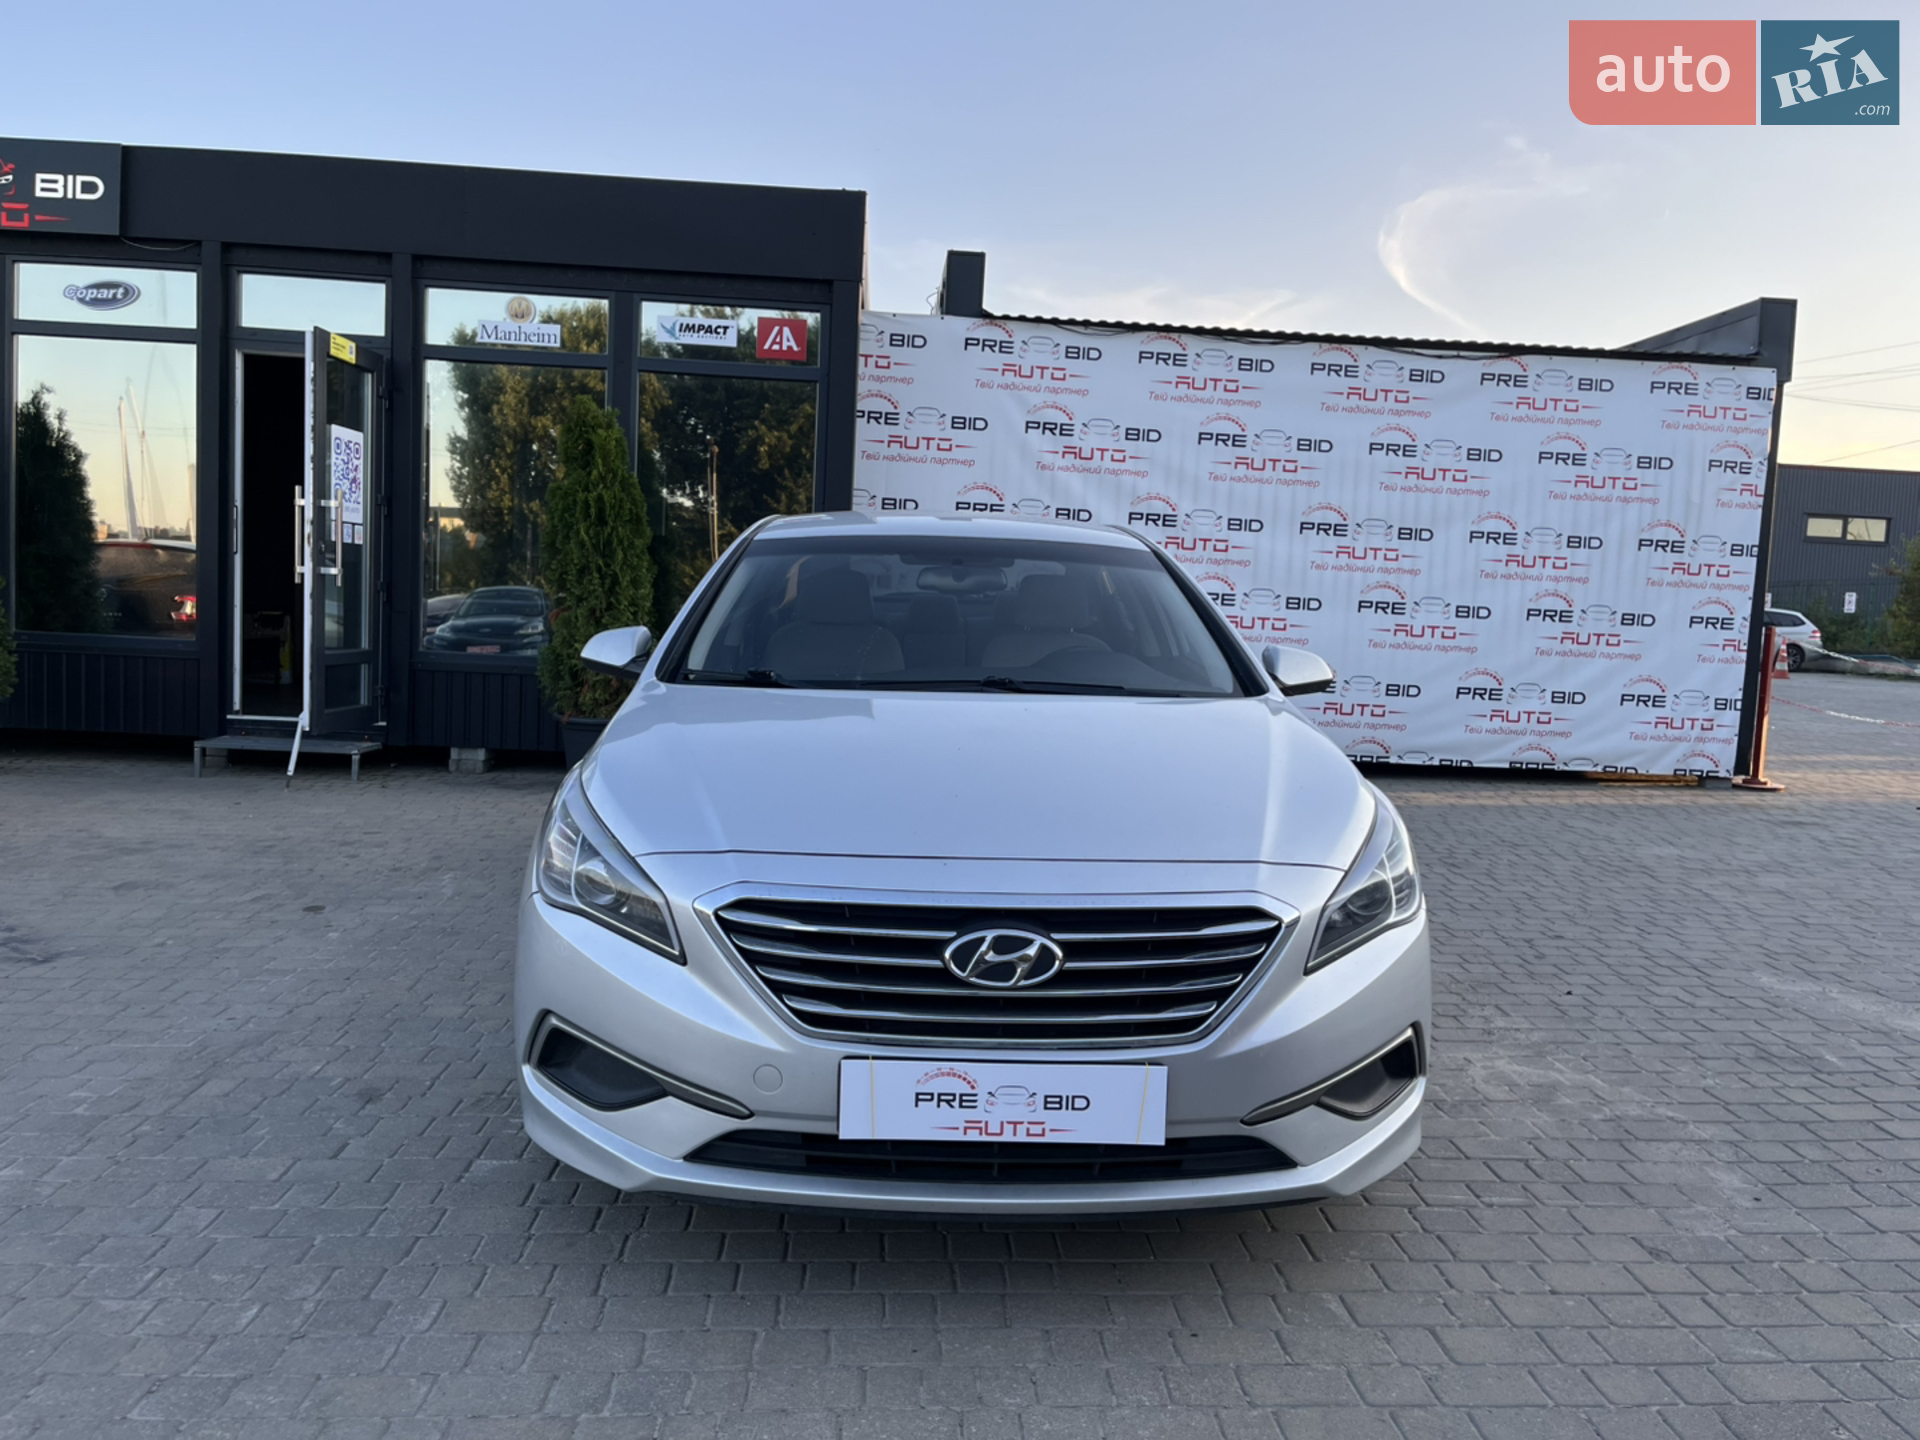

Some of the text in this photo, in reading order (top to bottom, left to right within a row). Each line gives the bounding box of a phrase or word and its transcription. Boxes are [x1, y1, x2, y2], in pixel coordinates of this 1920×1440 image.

[35, 172, 105, 201] BID
[63, 284, 126, 302] Copart
[480, 323, 558, 345] Manheim
[678, 322, 730, 336] IMPACT
[889, 333, 927, 349] BID
[964, 337, 1102, 361] PRE BID
[859, 353, 891, 369] TO
[1138, 351, 1275, 373] PRE BID
[1001, 363, 1066, 381] AUTO
[1311, 362, 1445, 383] PRE BID
[975, 378, 1089, 398] Твій надійний партнер
[1175, 376, 1239, 393] AUTO
[1480, 373, 1614, 392] PRE BID
[1650, 381, 1699, 396] PRE
[1149, 391, 1261, 409] Твій надійний партнер
[1347, 387, 1410, 403] AUTO
[1320, 402, 1431, 419] Твій надійний партнер
[1516, 397, 1579, 413] AUTO
[1687, 404, 1747, 421] AUTO
[951, 416, 988, 431] BID
[1490, 412, 1602, 428] Твій надійний партнер
[1660, 420, 1680, 430] Твій
[1682, 421, 1724, 433] надійний
[1025, 420, 1162, 442] PRE BID
[887, 435, 952, 452] AUTO
[1198, 432, 1333, 453] PRE BID
[861, 450, 975, 468] Твій надійний партнер
[1062, 445, 1126, 463] AUTO
[1369, 442, 1503, 462] PRE BID
[1234, 456, 1298, 473] AUTO
[1538, 451, 1673, 470] PRE BID
[1708, 459, 1753, 475] PRE
[1035, 461, 1149, 479] Твій надійний партнер
[1405, 466, 1468, 483] AUTO
[1208, 472, 1320, 489] Твій надійний партнер
[1574, 475, 1638, 491] AUTO
[1379, 482, 1490, 499] Твій надійний партнер
[1548, 490, 1660, 506] Твій надійний партнер
[881, 497, 919, 510] BID
[1715, 498, 1733, 509] Твій
[1055, 508, 1092, 523] BID
[1128, 512, 1264, 532] PRE BID
[1300, 522, 1434, 541] PRE BID
[1165, 536, 1229, 552] AUTO
[1469, 531, 1603, 549] PRE BID
[1638, 539, 1685, 553] PRE
[1336, 546, 1399, 562] AUTO
[1505, 554, 1568, 570] AUTO
[1205, 557, 1251, 568] партнер
[1310, 561, 1421, 577] Твій надійний партнер
[1671, 562, 1731, 578] AUTO
[1480, 569, 1590, 585] Твій надійний партнер
[1645, 577, 1750, 593] Твій надійний партнер
[1206, 592, 1322, 611] RE BID
[1358, 600, 1491, 619] PRE BID
[1526, 608, 1656, 627] PRE BID
[1689, 616, 1735, 630] PRE
[1393, 624, 1456, 640] AUTO
[1560, 632, 1621, 647] AUTO
[1264, 635, 1309, 646] партнер
[1368, 639, 1478, 655] Твій надійний партнер
[1535, 647, 1642, 662] Твій надійний партнер
[1697, 654, 1715, 664] Твій
[1385, 684, 1421, 698] BID
[1456, 687, 1586, 704] PRE BID
[1620, 693, 1667, 708] PRE
[1323, 702, 1386, 718] AUTO
[1490, 709, 1552, 724] AUTO
[1317, 719, 1361, 729] надійний
[1363, 721, 1407, 732] партнер
[1654, 716, 1715, 731] AUTO
[1464, 725, 1572, 739] Твій надійний партнер
[1628, 731, 1648, 741] Твій
[914, 1092, 1091, 1111] PRE BID
[963, 1120, 1046, 1137] AUTO
